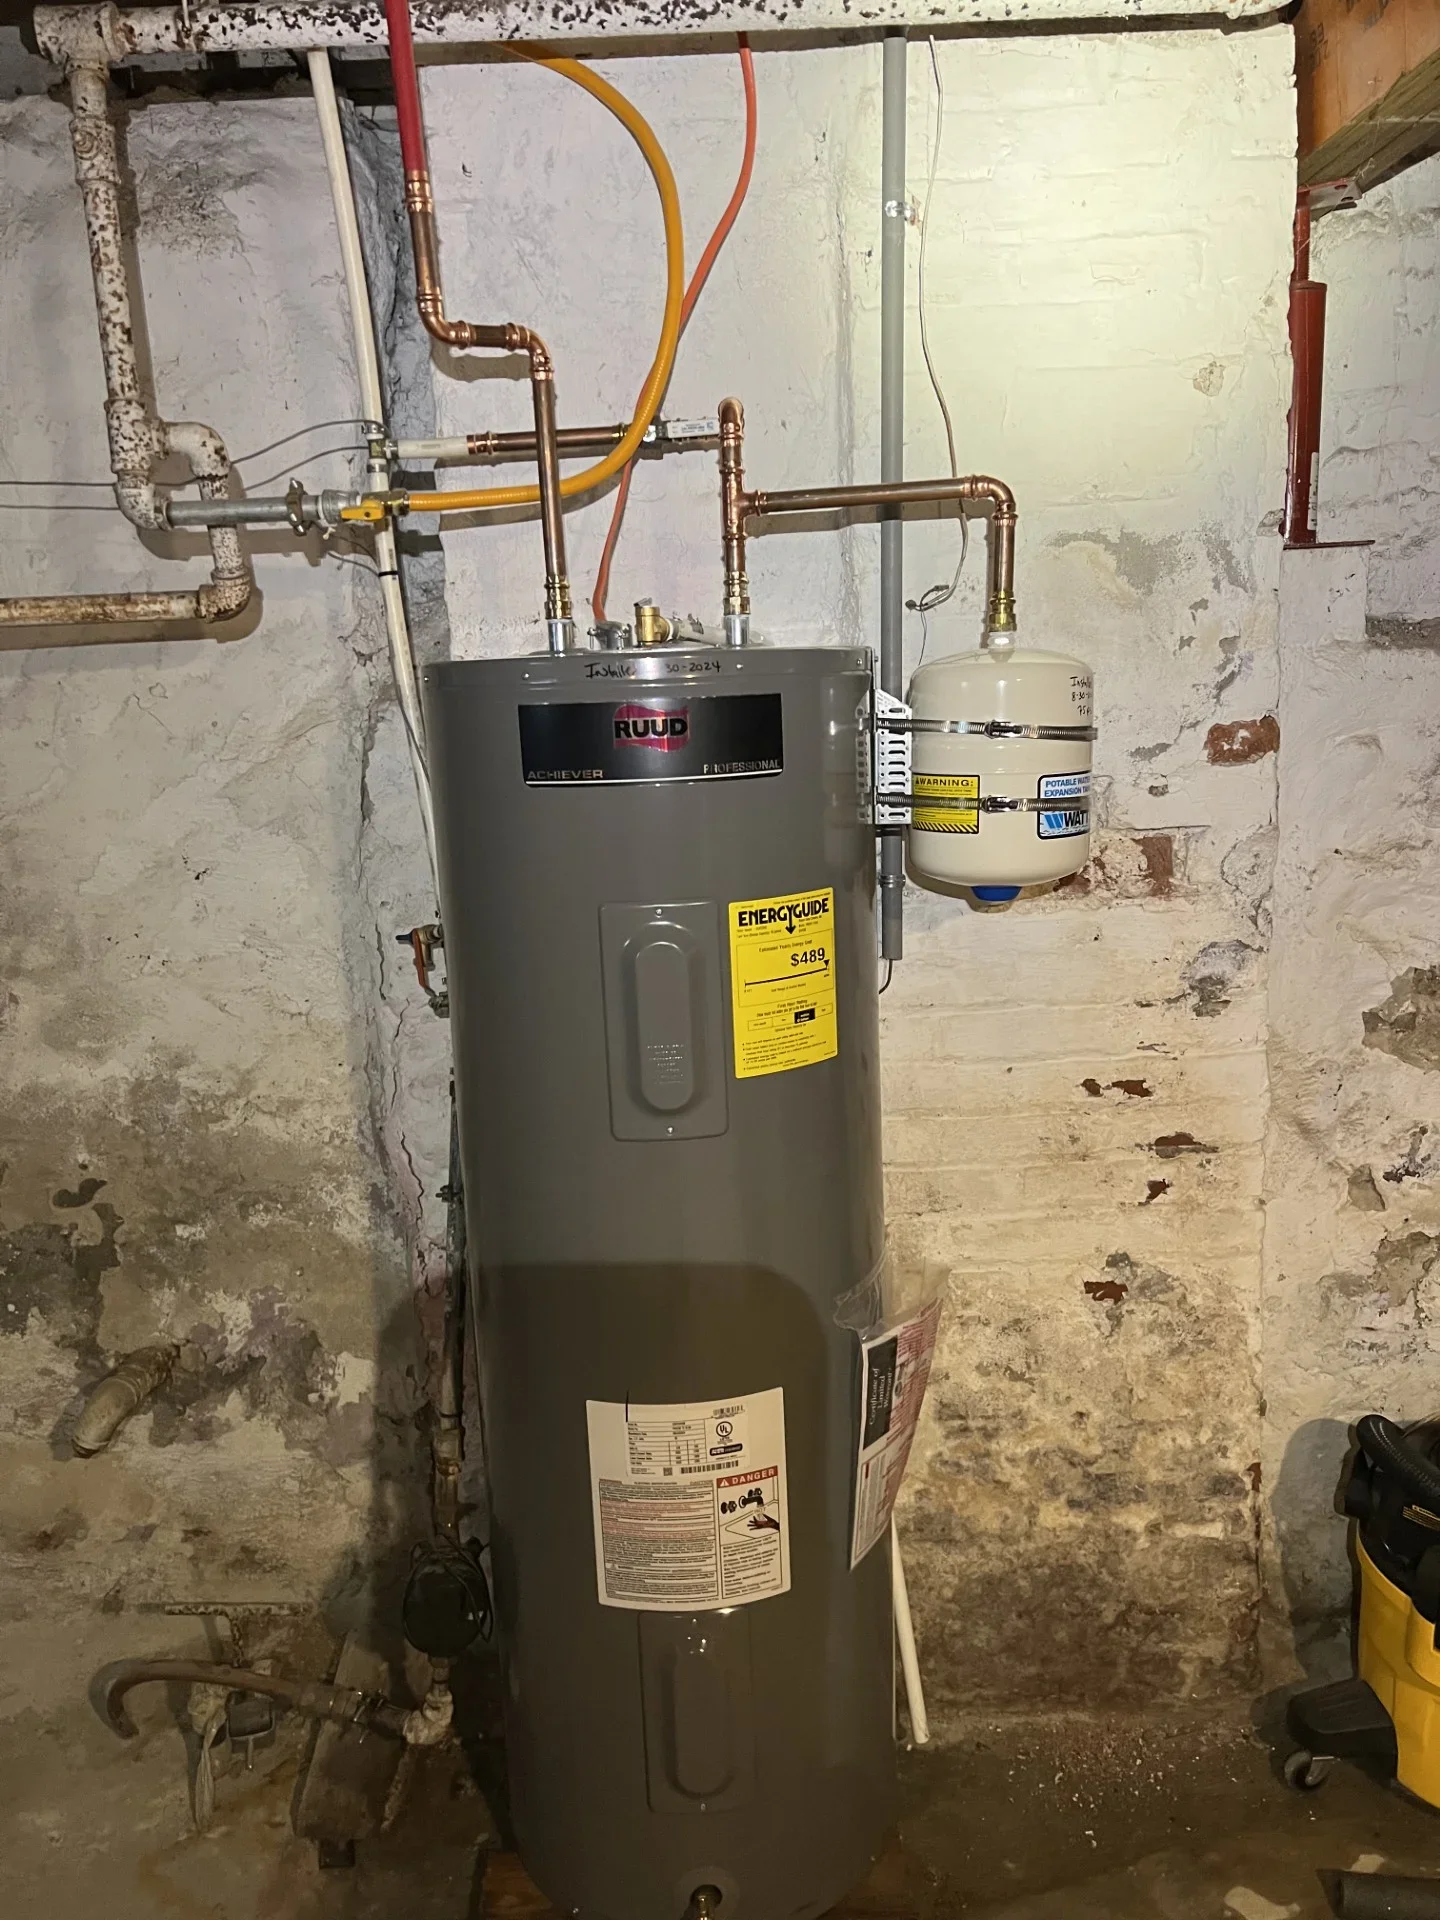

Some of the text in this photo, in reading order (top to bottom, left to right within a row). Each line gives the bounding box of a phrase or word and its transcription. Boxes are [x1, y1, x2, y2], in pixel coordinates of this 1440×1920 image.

[614, 719, 688, 739] RUUD
[527, 769, 603, 780] ACHIEVER
[703, 759, 780, 774] PROFESSIONAL
[1045, 778, 1077, 788] POTABLE
[1044, 786, 1082, 797] EXPANSION
[738, 897, 830, 929] ENERGYGUIDE
[790, 947, 825, 967] $489
[732, 1468, 775, 1486] DANGER
